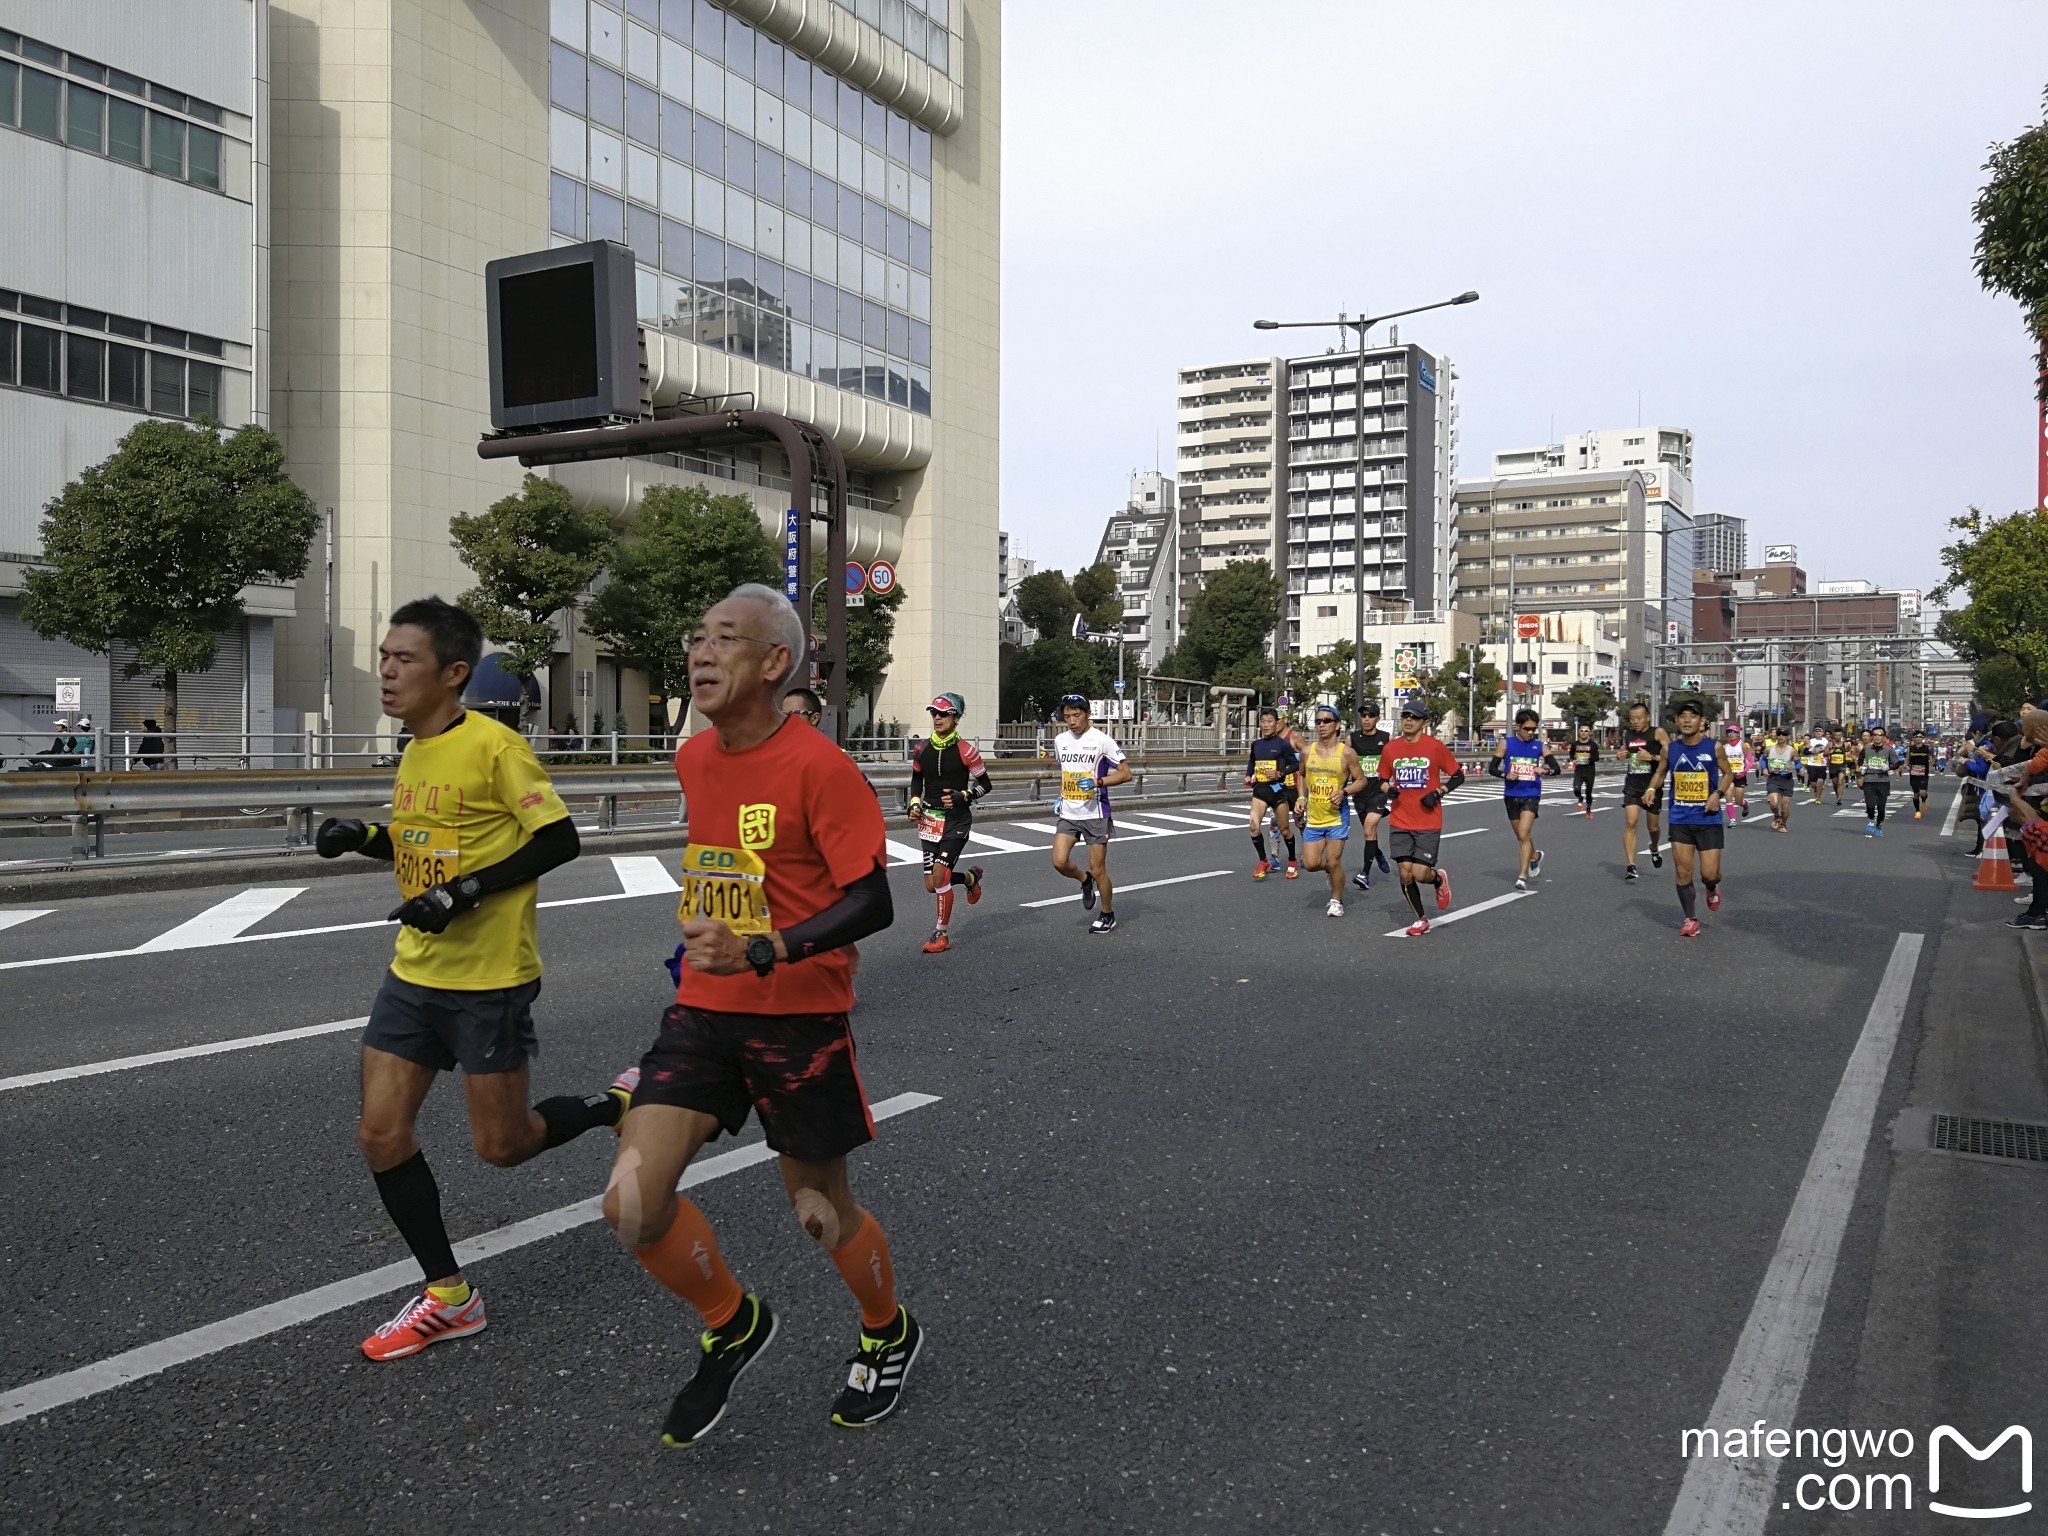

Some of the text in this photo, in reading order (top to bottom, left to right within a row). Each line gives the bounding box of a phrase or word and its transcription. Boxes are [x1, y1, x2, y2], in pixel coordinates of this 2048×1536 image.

[787, 513, 798, 595] 大阪府警察
[874, 570, 890, 585] 50
[1396, 768, 1422, 780] A22117
[1511, 763, 1534, 774] A72035
[1676, 781, 1704, 792] A50029
[402, 828, 431, 846] eo
[699, 850, 735, 869] eo
